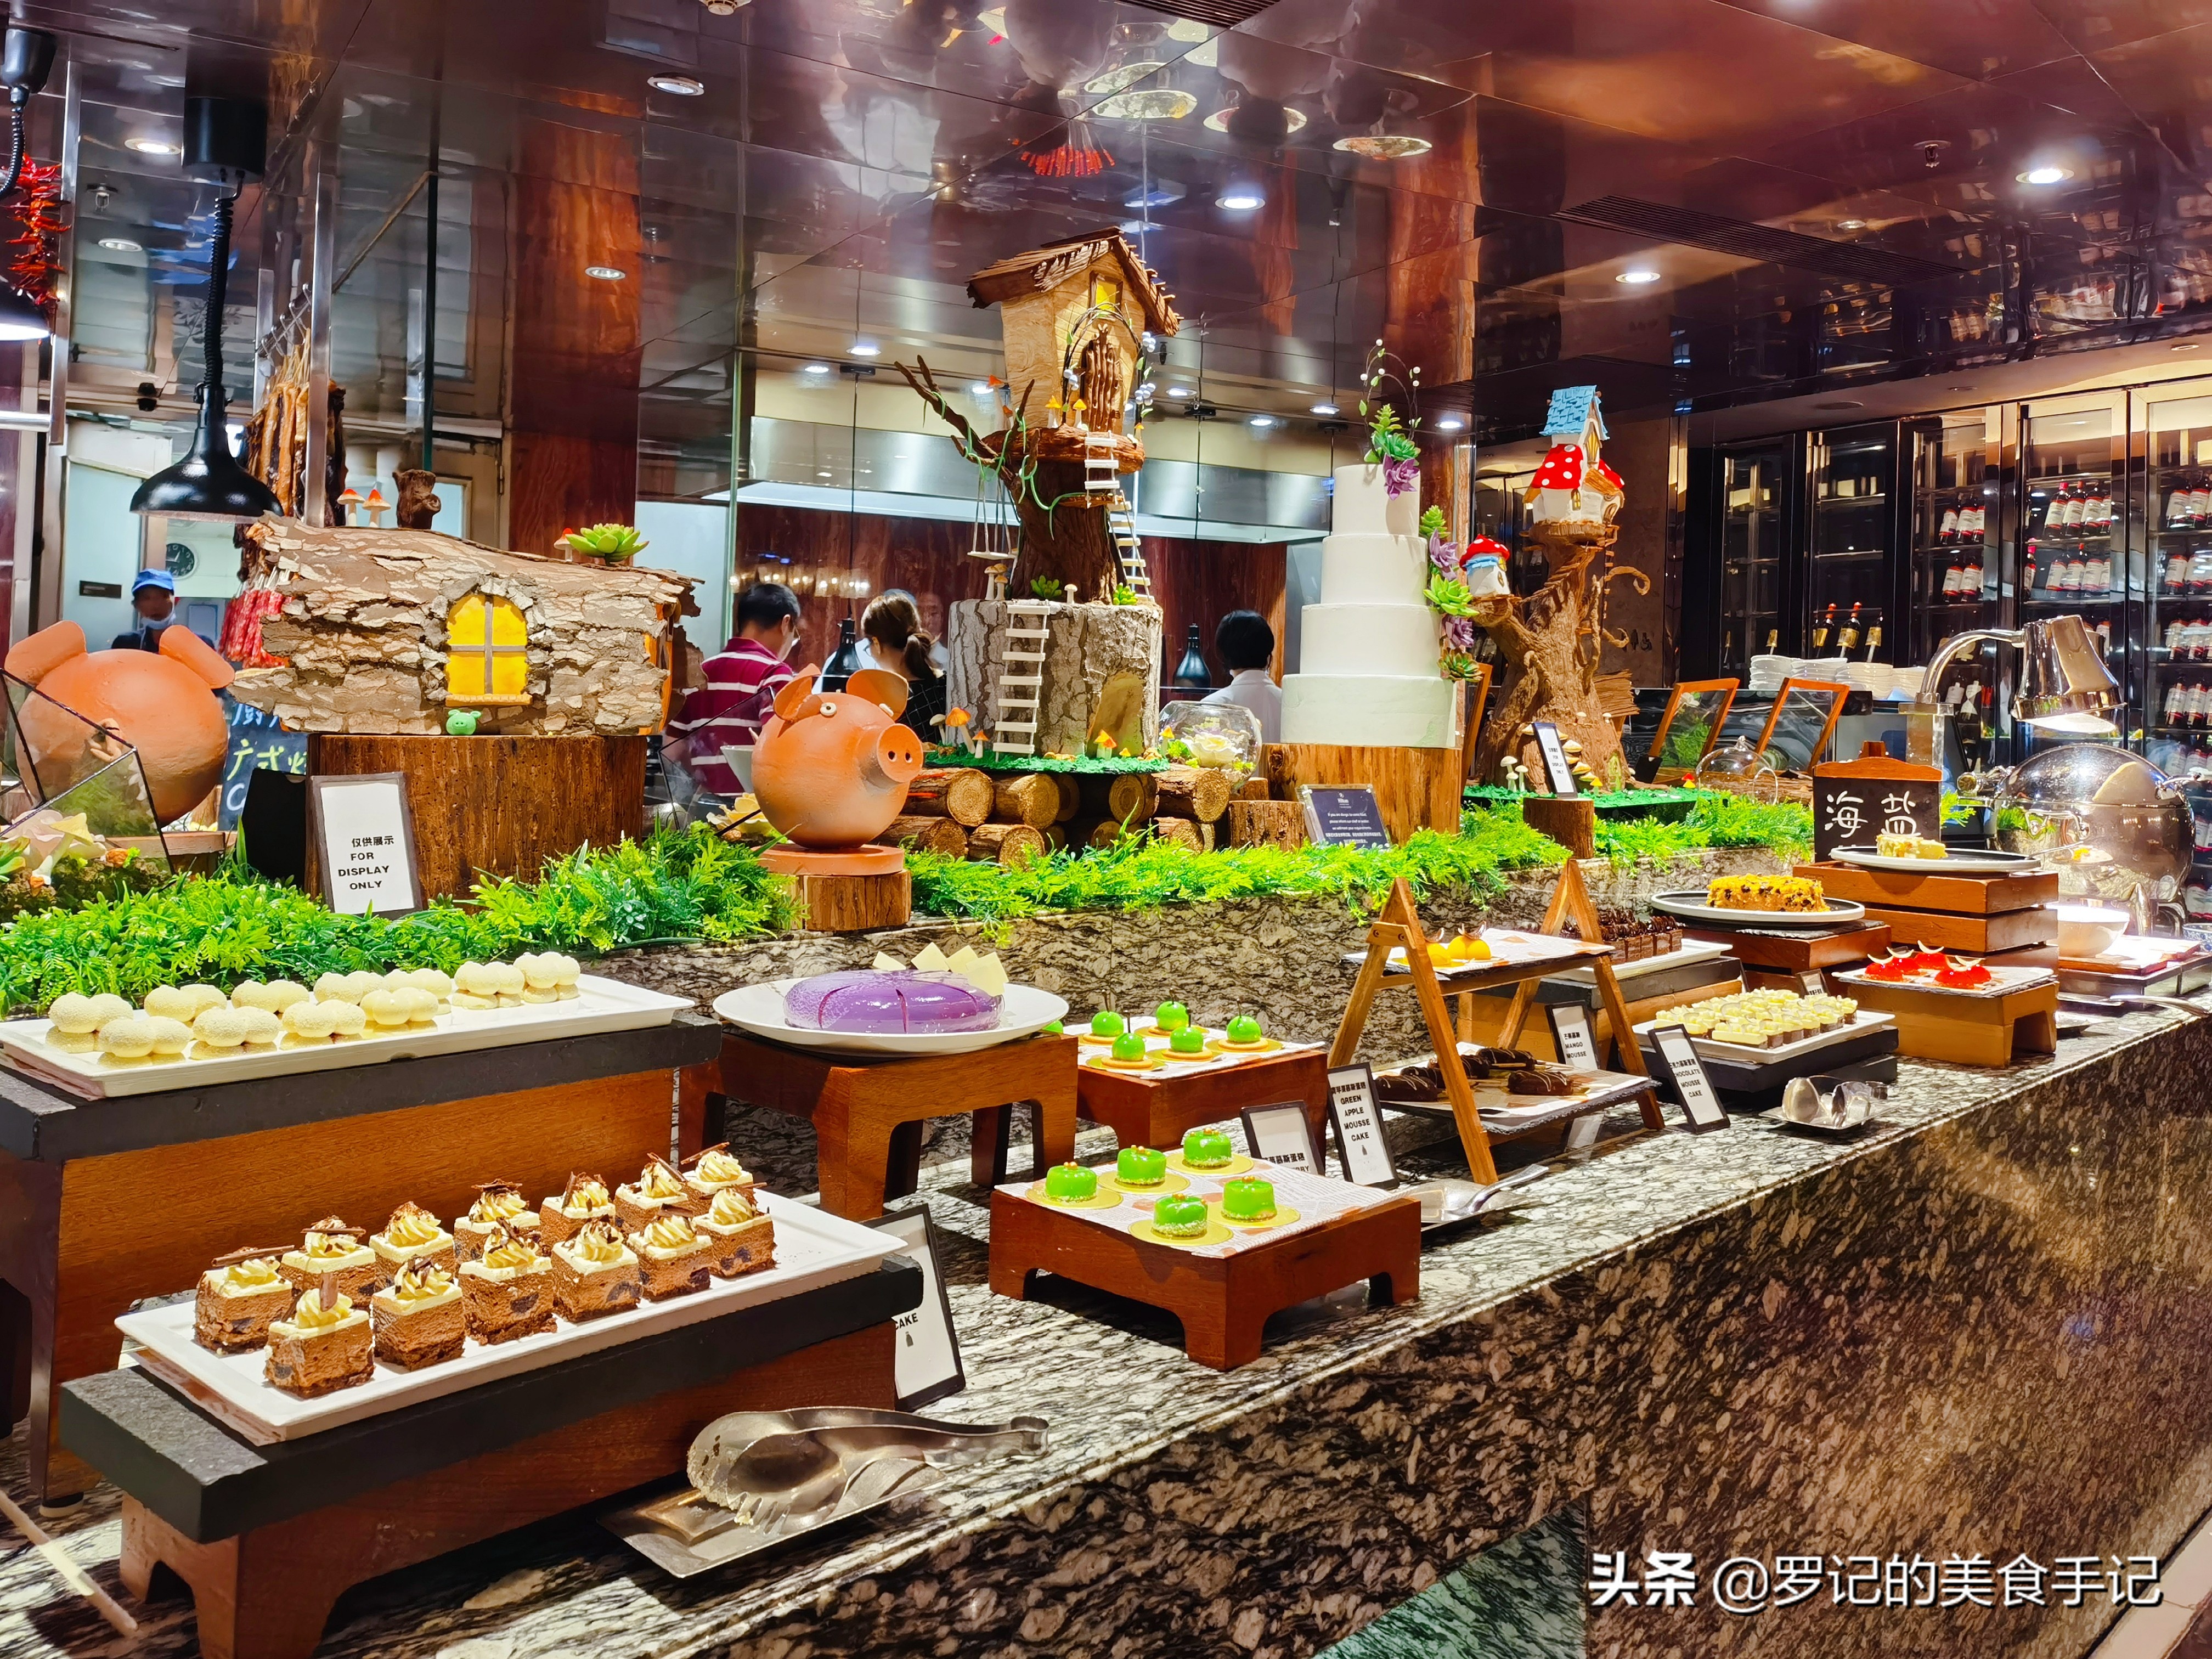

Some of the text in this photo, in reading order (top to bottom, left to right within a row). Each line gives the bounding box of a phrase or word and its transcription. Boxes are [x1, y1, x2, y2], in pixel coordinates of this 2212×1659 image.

[1824, 791, 1921, 838] 海盐
[351, 836, 394, 848] 仅供展示
[351, 852, 374, 861] FOR
[338, 865, 390, 877] DISPLAY
[349, 881, 382, 890] ONLY
[1674, 1069, 1701, 1077] HOCOLATE
[1681, 1079, 1701, 1088] MOUSSE
[1340, 1094, 1362, 1104] GREEN
[1345, 1107, 1364, 1116] APPLE
[1344, 1119, 1370, 1130] MOUSSE
[1351, 1132, 1369, 1141] CAKE
[895, 1313, 918, 1330] CAKE
